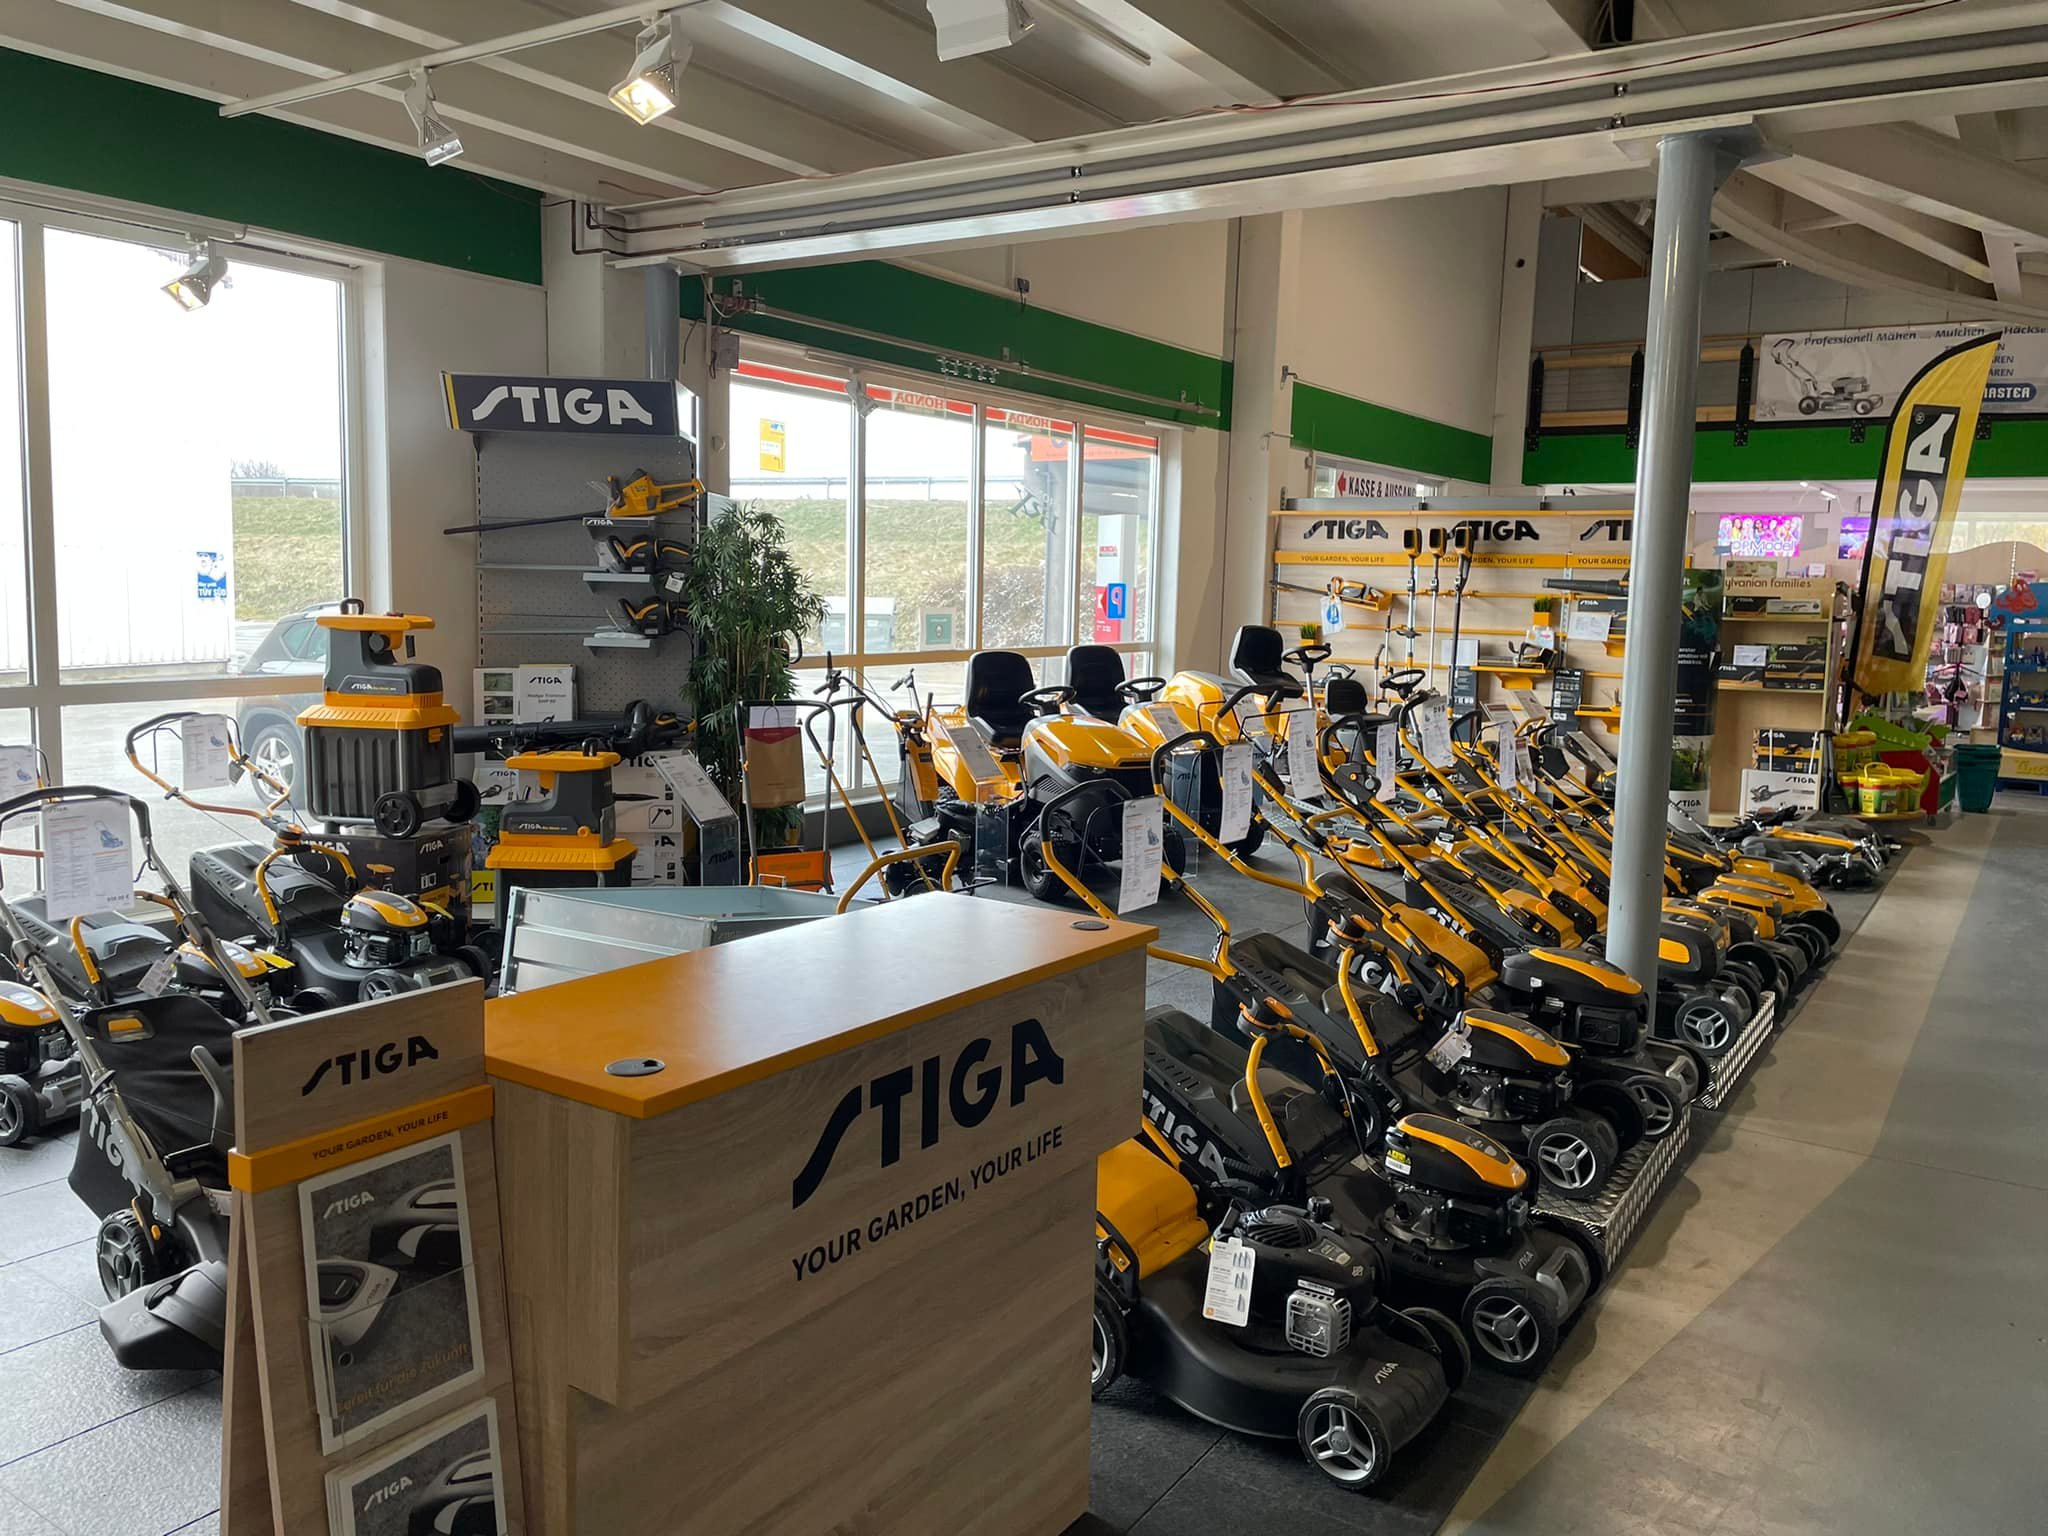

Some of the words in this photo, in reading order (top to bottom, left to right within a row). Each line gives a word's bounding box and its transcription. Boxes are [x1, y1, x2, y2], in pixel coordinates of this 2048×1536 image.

[1804, 333, 1872, 347] Professionell
[1877, 333, 1916, 341] Mähen
[1936, 328, 1985, 338] Mulchen
[472, 386, 653, 425] STIGA
[1349, 476, 1375, 497] KASSE
[1377, 481, 1382, 497] &
[586, 518, 614, 526] STIGA
[1304, 520, 1388, 539] STIGA
[1580, 520, 1631, 541] STI
[1883, 413, 1957, 655] STIGA
[1725, 578, 1768, 590] ylvanian
[1770, 577, 1812, 588] families
[1785, 776, 1816, 784] STIGA
[420, 840, 443, 854] STIGA
[472, 882, 494, 891] STI
[302, 1036, 438, 1096] STIGA
[792, 1018, 1064, 1210] STIGA
[313, 1144, 344, 1160] YOUR
[345, 1129, 394, 1149] GARDEN,
[397, 1118, 425, 1133] YOUR
[427, 1111, 449, 1125] LIFE
[1143, 1089, 1229, 1183] TIGA
[323, 1190, 375, 1219] STIGA
[792, 1228, 861, 1281] YOUR
[867, 1176, 965, 1242] GARDEN,
[970, 1146, 1022, 1190] YOUR
[1027, 1125, 1063, 1162] LIFE
[1375, 1363, 1399, 1384] STIGA
[364, 1476, 413, 1511] STIGA
